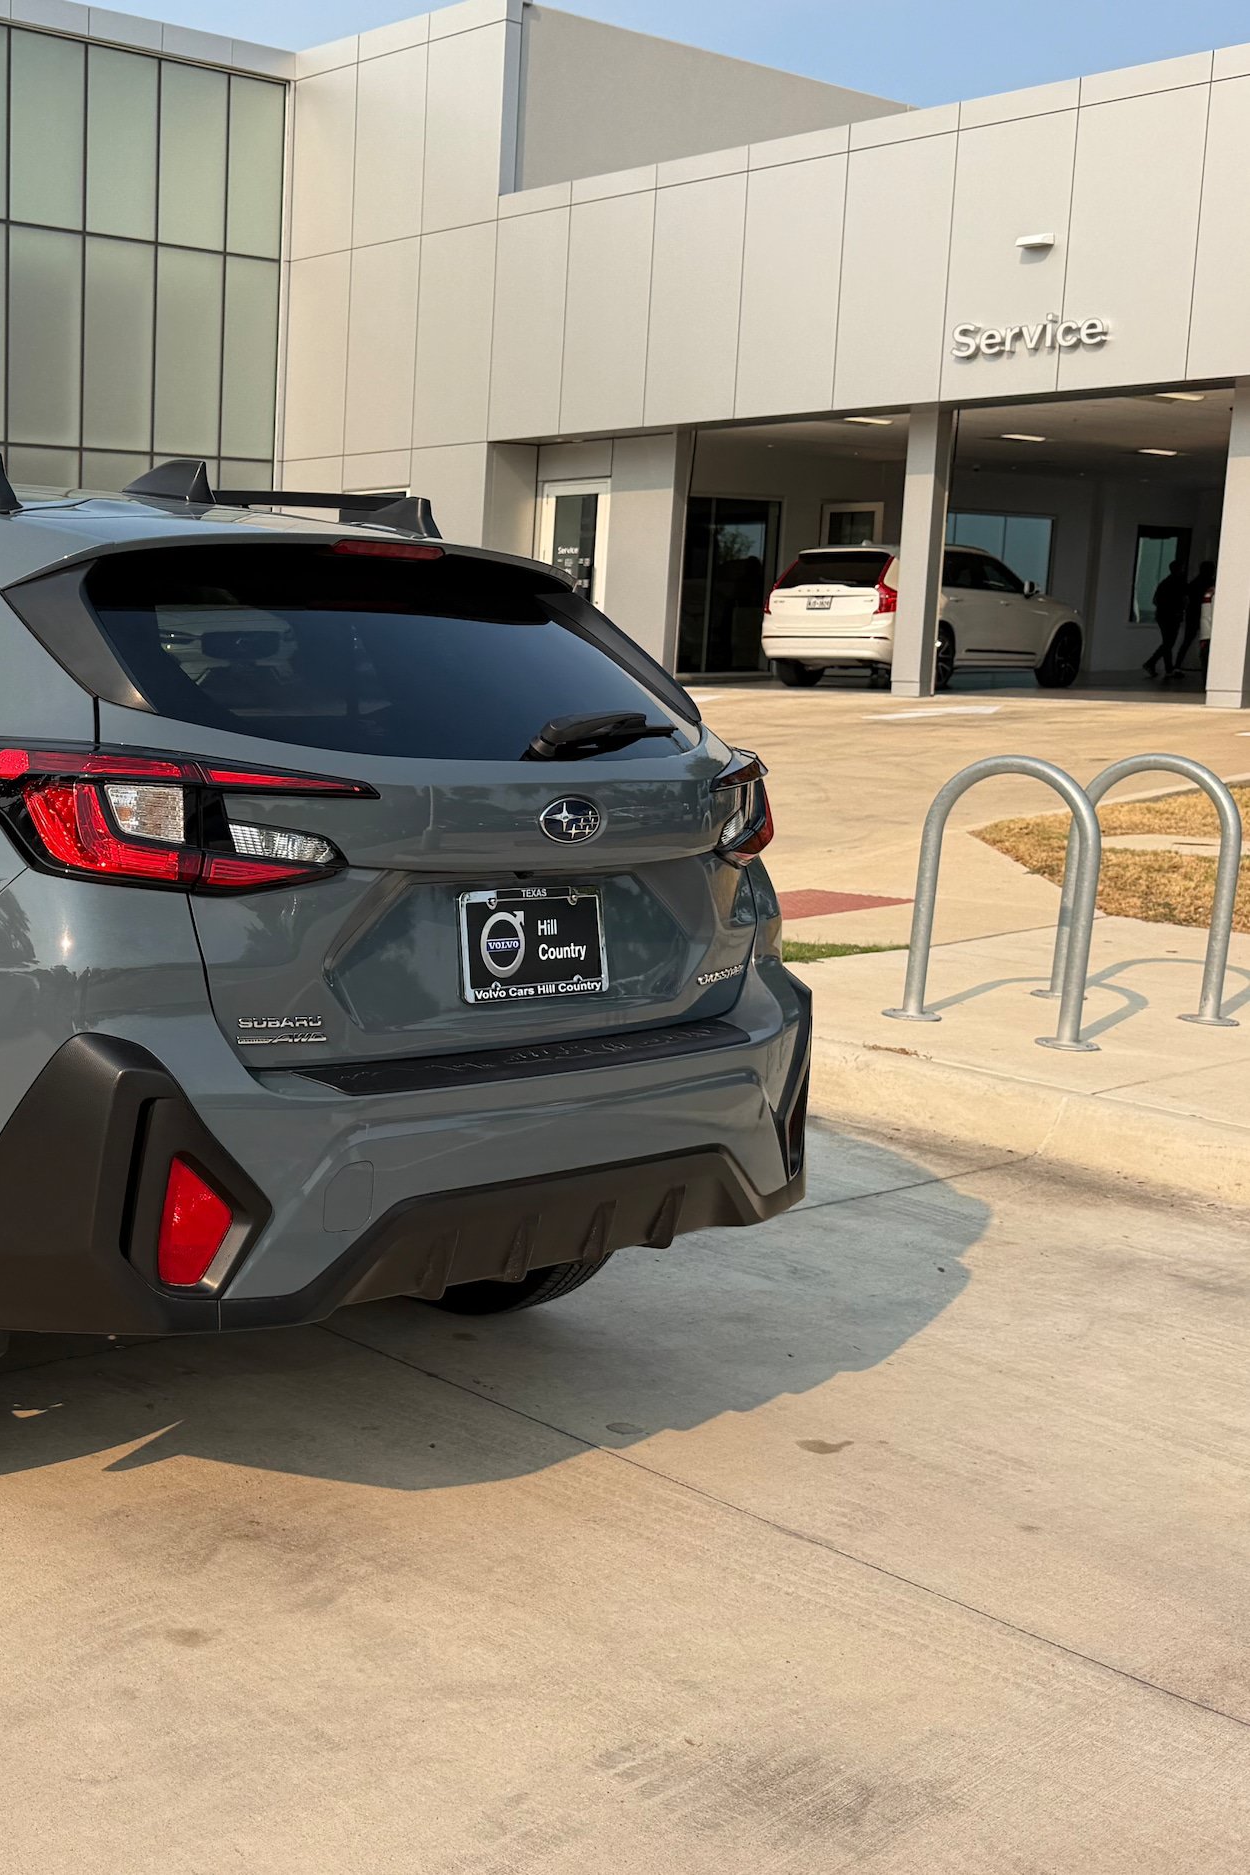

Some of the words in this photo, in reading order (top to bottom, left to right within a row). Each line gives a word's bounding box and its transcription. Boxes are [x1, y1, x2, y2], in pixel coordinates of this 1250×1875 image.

[950, 312, 1105, 358] Service
[557, 546, 579, 555] Service
[521, 888, 547, 898] TEXAS
[537, 919, 558, 936] Hill
[487, 940, 520, 950] VOLVO
[538, 942, 587, 961] Country
[475, 989, 506, 1000] Volvo
[508, 987, 535, 997] Cars
[537, 984, 556, 994] Hill
[558, 981, 602, 992] Country
[238, 1015, 322, 1029] SUBARU
[271, 1031, 327, 1043] AWD
